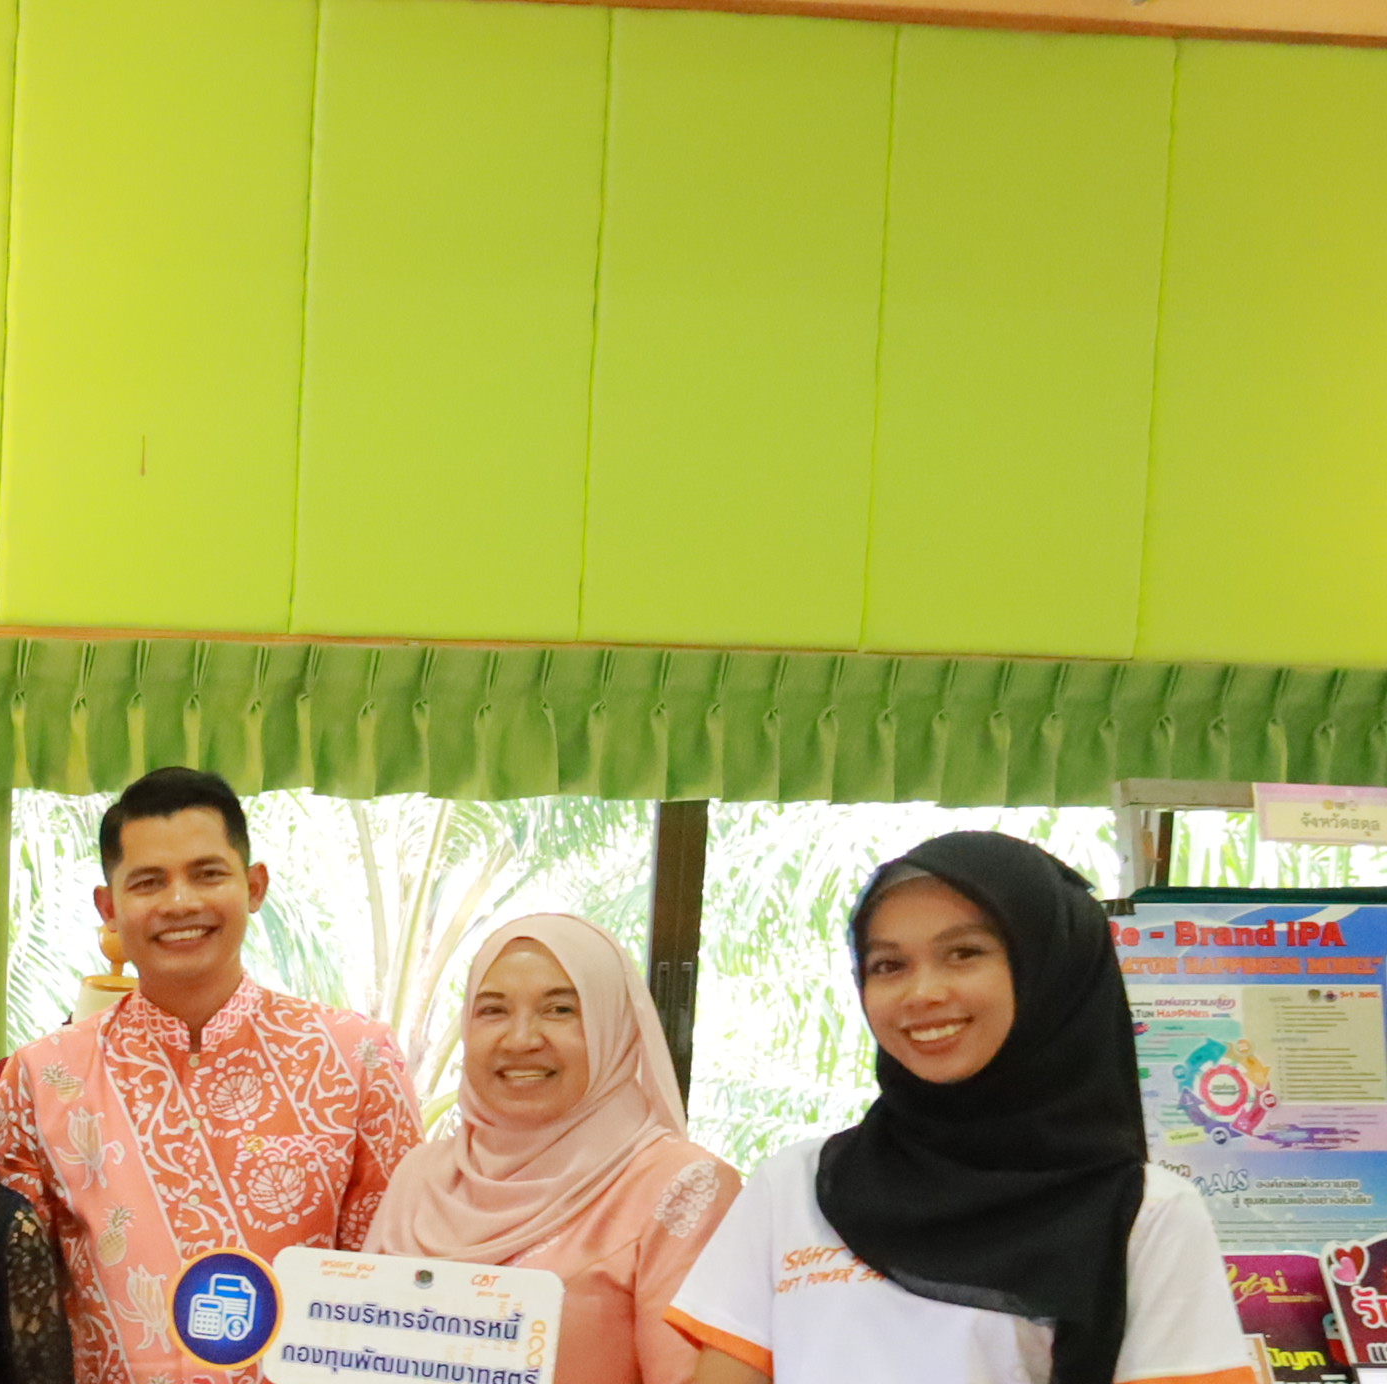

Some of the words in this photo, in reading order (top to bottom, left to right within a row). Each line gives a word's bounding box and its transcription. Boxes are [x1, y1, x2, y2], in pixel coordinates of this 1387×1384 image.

[1300, 812, 1380, 836] จังหวัดสตูล
[1174, 920, 1276, 947] Brand
[1287, 921, 1347, 947] IPA
[471, 1274, 501, 1288] CBT
[309, 1301, 524, 1340] การบริหารจัดการหนี้
